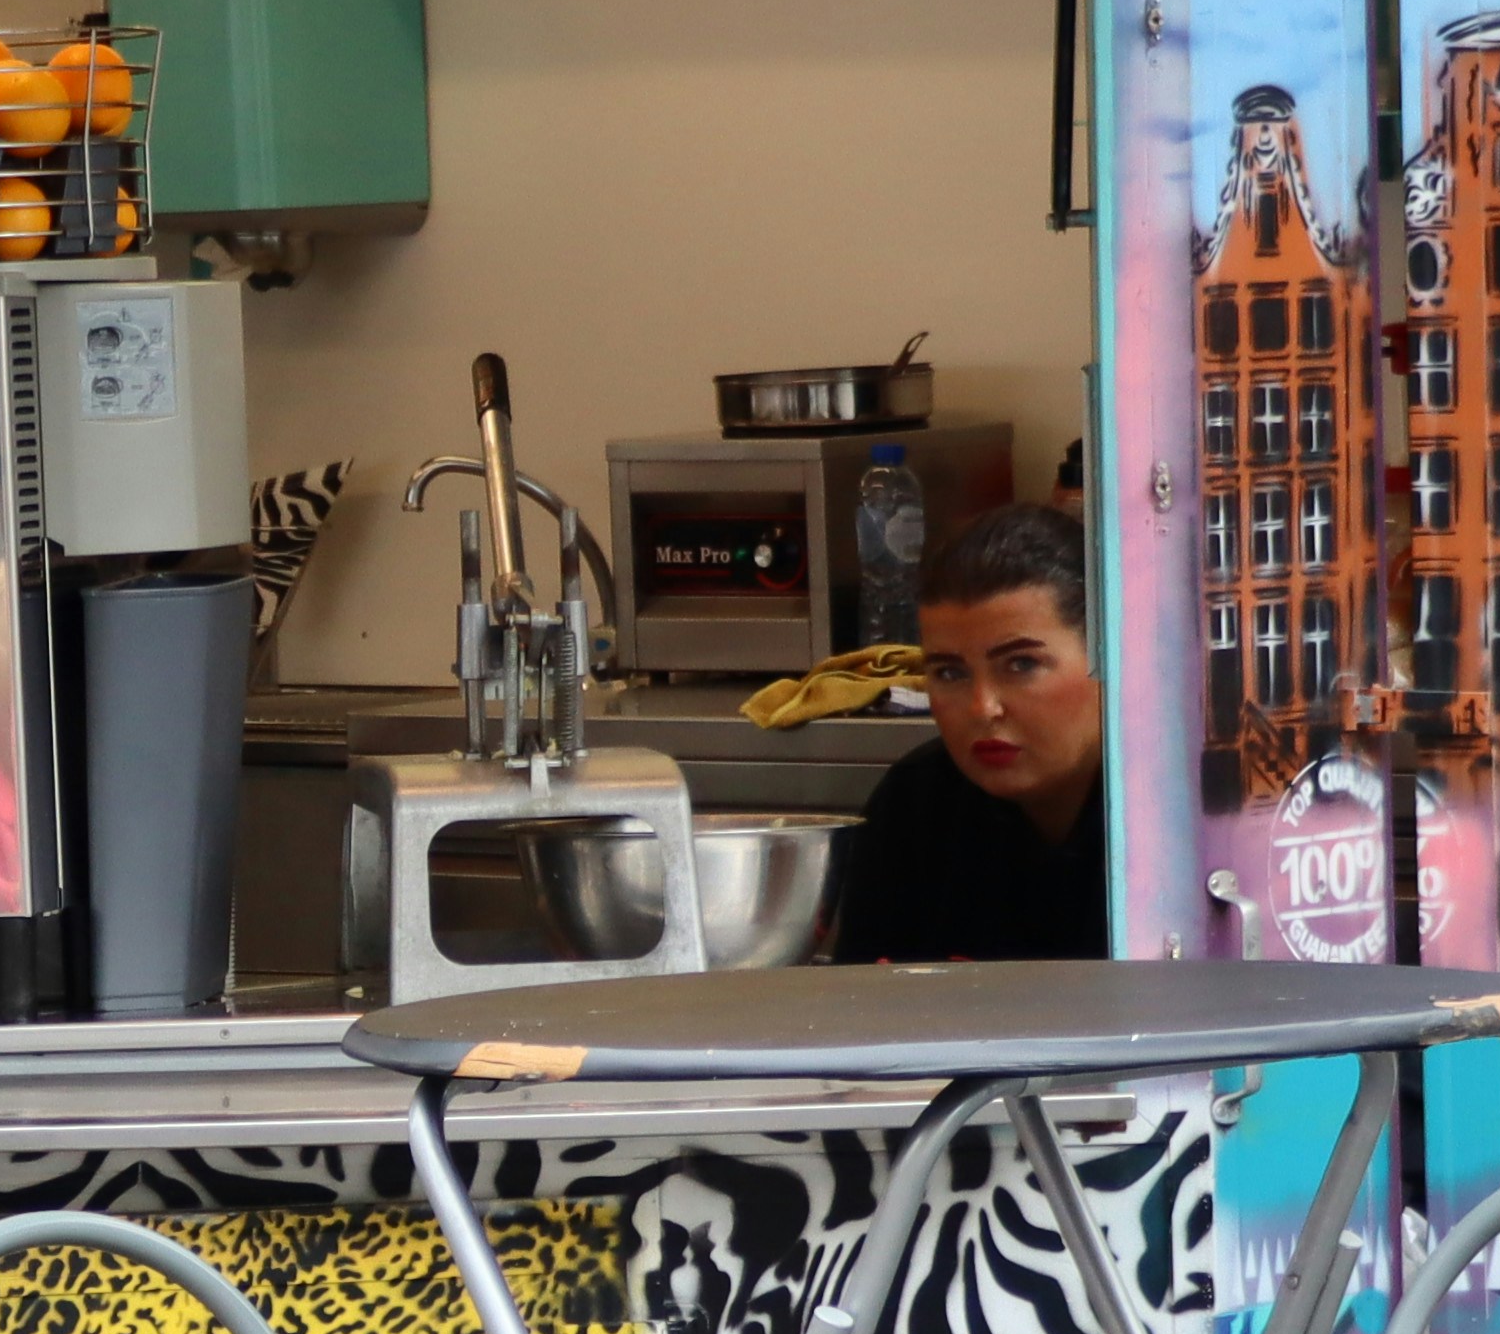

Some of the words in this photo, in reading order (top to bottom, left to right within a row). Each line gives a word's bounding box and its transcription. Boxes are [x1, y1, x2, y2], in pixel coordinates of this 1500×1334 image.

[655, 545, 694, 564] Max
[699, 546, 732, 564] Pro
[1282, 779, 1315, 828] TOP
